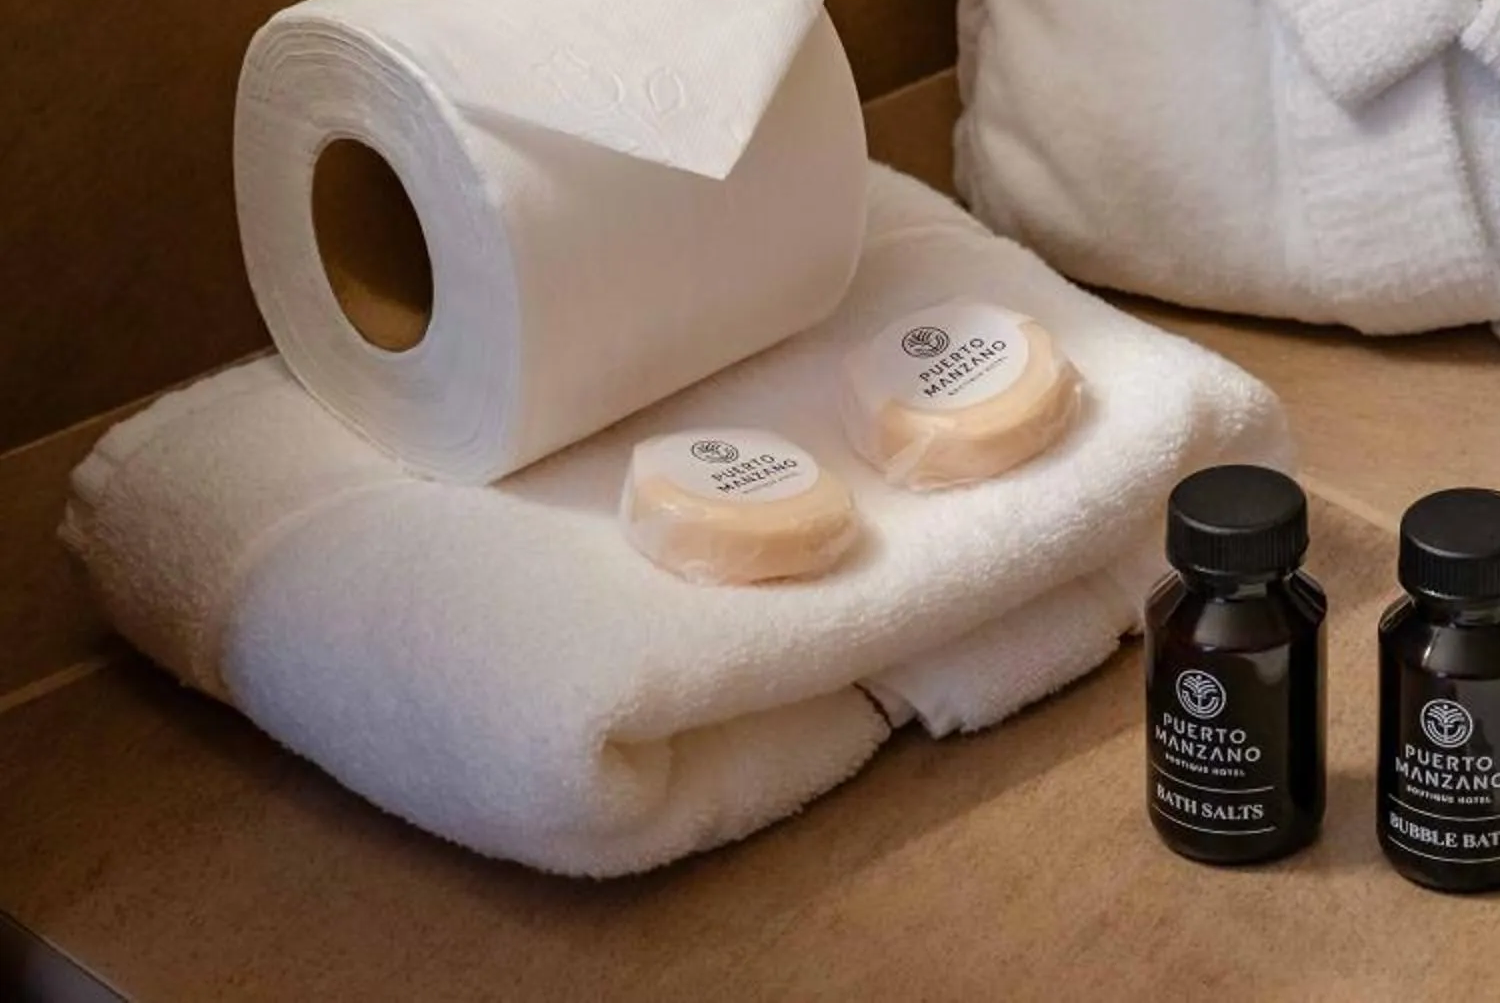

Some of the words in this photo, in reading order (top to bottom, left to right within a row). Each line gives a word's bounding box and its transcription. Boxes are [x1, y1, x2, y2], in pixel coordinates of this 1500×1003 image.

[918, 337, 985, 382] PUERTO
[923, 340, 1007, 398] MANZANO
[711, 453, 776, 483] PUERTO
[715, 457, 798, 494] MANZANO
[1154, 724, 1262, 763] MANZANO
[1162, 711, 1247, 745] PUERTO
[1404, 743, 1494, 772] PUERTO
[1156, 783, 1198, 816] BATH
[1200, 802, 1265, 820] SALTS
[1388, 810, 1458, 848] BUBBLE
